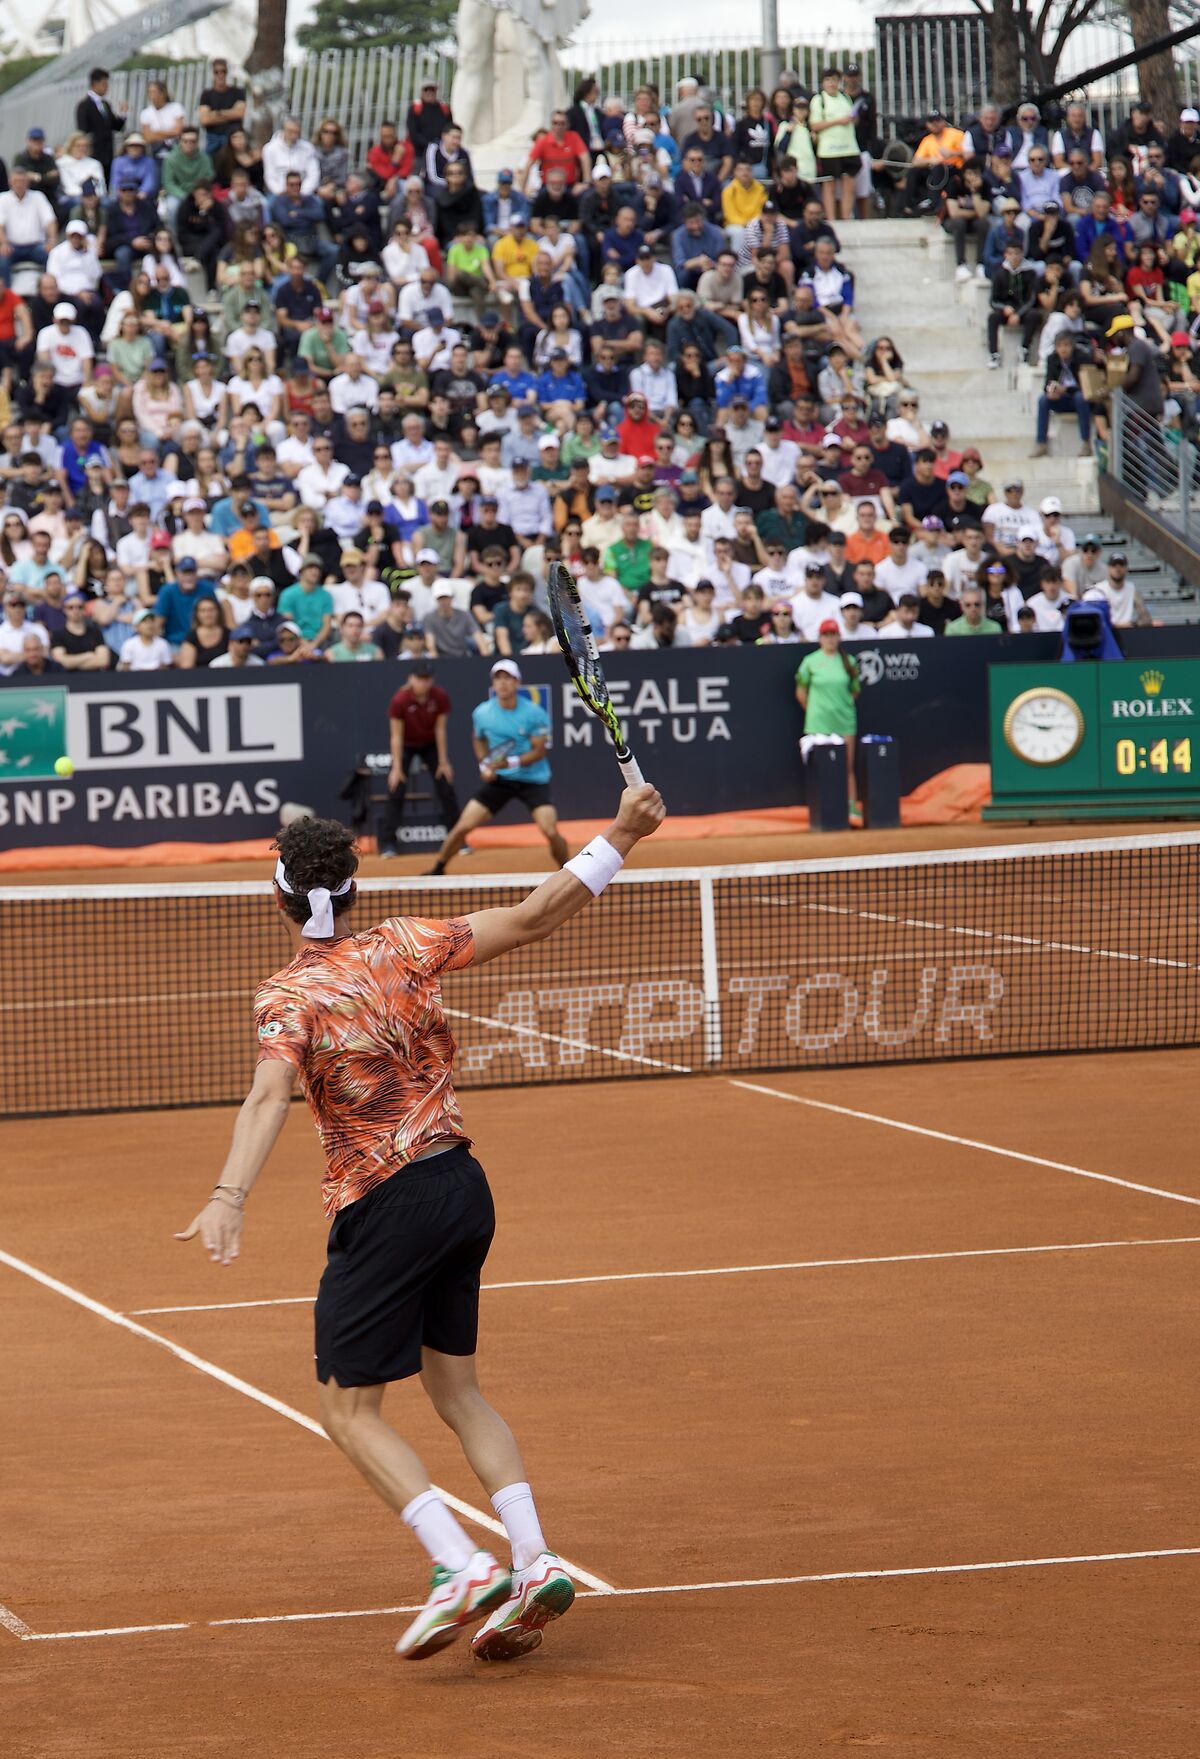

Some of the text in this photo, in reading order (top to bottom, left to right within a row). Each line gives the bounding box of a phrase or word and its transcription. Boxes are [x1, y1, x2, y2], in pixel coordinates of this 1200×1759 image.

[884, 653, 920, 667] WTA
[886, 667, 919, 681] 1000
[562, 676, 731, 718] REALE
[1112, 698, 1194, 718] ROLEX
[86, 696, 276, 759] BNL
[564, 716, 732, 747] MUTUA
[1116, 737, 1192, 775] 0:44
[87, 779, 280, 823] PARIBAS
[460, 965, 1004, 1072] ATP TOUR
